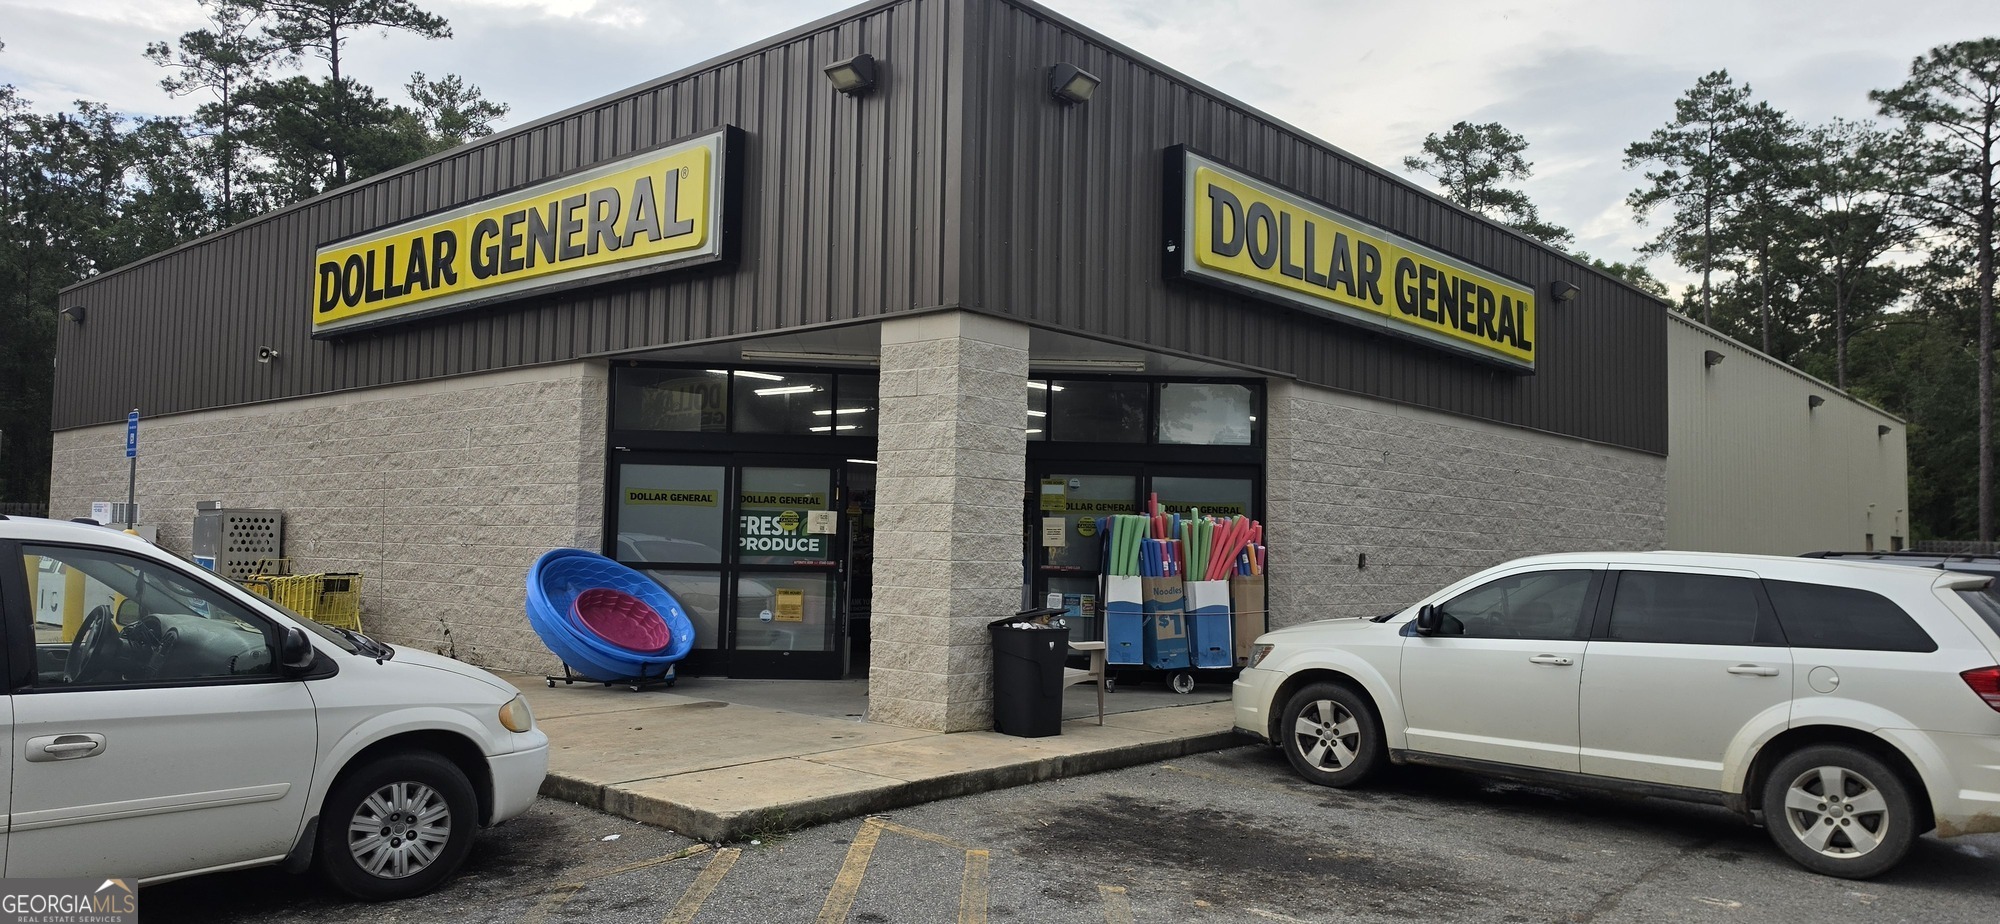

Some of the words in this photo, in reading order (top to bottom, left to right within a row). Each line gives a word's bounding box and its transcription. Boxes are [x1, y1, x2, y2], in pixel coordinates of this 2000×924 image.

[318, 230, 458, 314] DOLLAR
[470, 168, 694, 280] GENERAL
[1208, 183, 1383, 306] DOLLAR
[1394, 256, 1532, 352] GENERAL
[630, 492, 667, 501] DOLLAR
[670, 493, 713, 502] GENERAL
[740, 495, 776, 504] DOLLAR
[779, 496, 821, 505] GENERAL
[1066, 503, 1093, 511] OLLAR
[1096, 503, 1136, 512] GENERAL
[1201, 505, 1241, 514] GENERAL
[739, 537, 820, 552] PRODUCE
[1153, 586, 1182, 596] Noodles
[1158, 612, 1182, 635] $1
